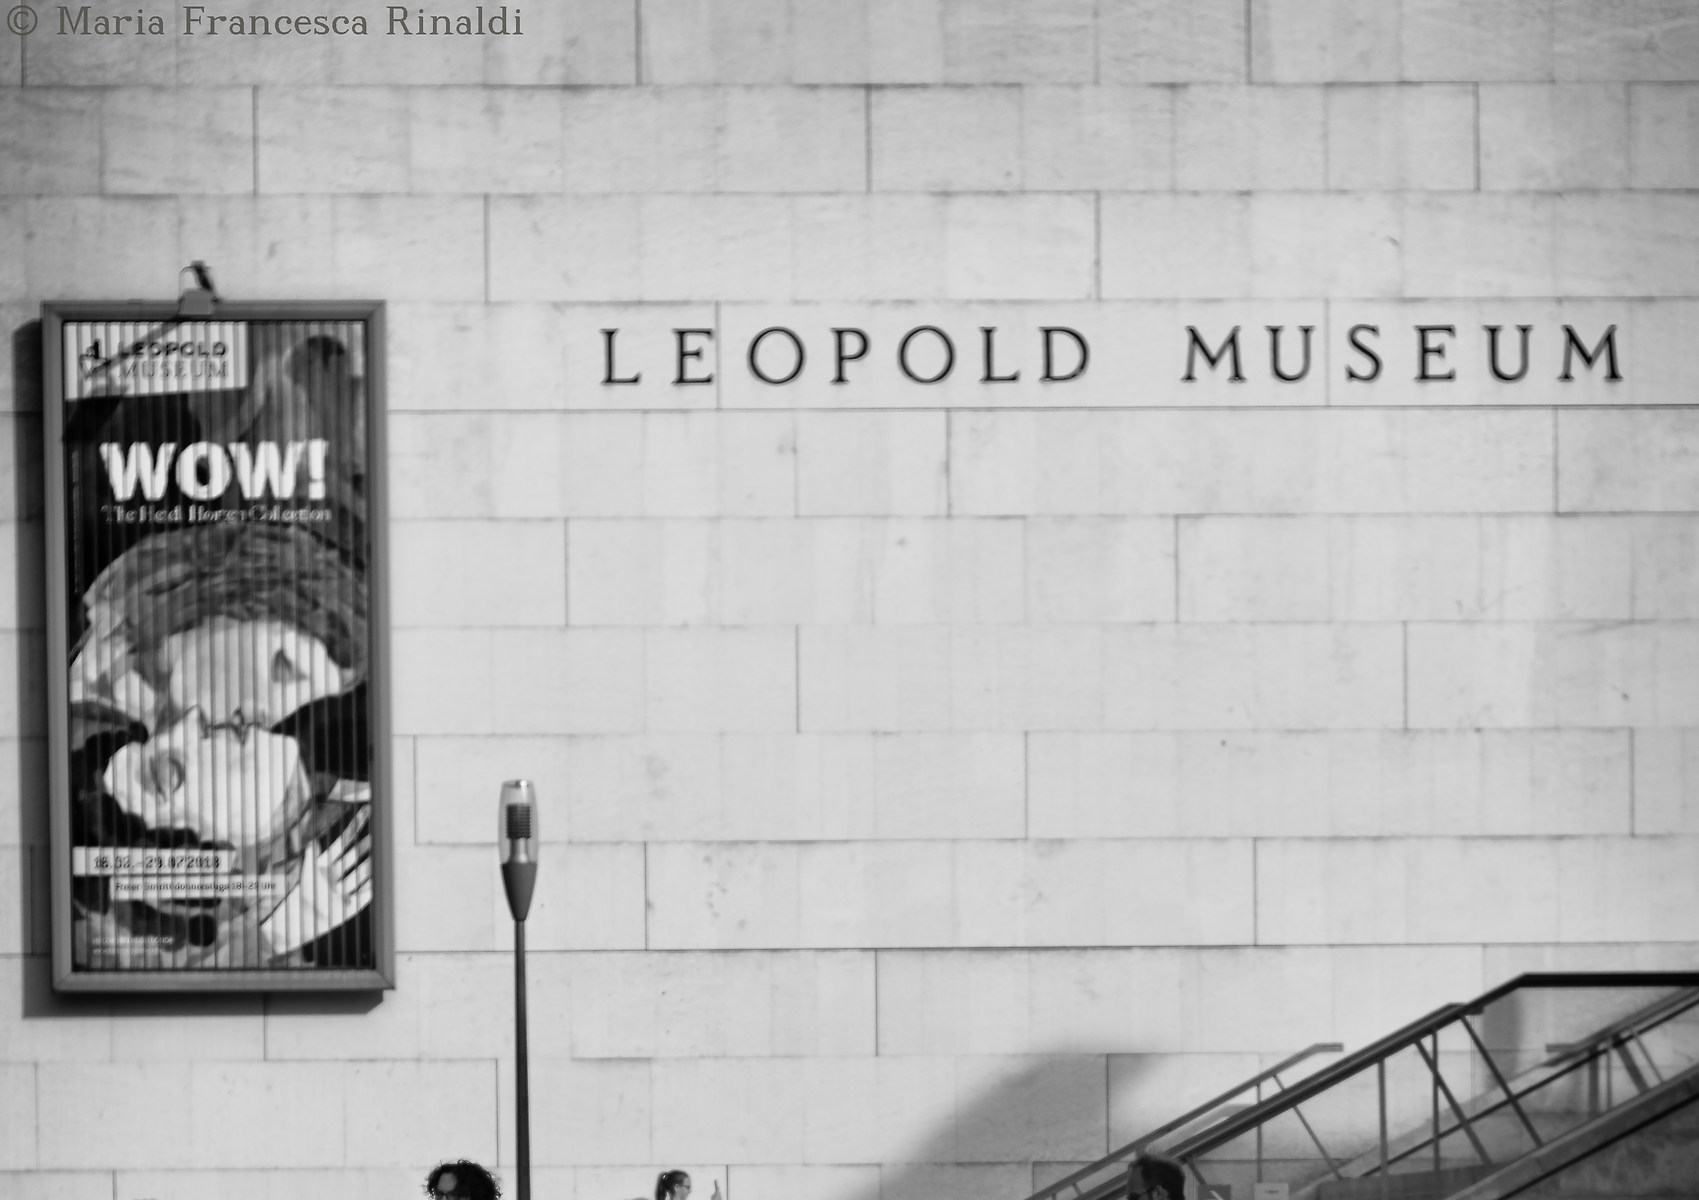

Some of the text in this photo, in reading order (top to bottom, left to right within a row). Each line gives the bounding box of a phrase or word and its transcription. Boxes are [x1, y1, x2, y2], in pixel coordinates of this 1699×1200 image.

[118, 361, 228, 378] MUSEUM
[600, 325, 1624, 384] LEOPOLD MUSEUM
[98, 437, 329, 502] WOW!
